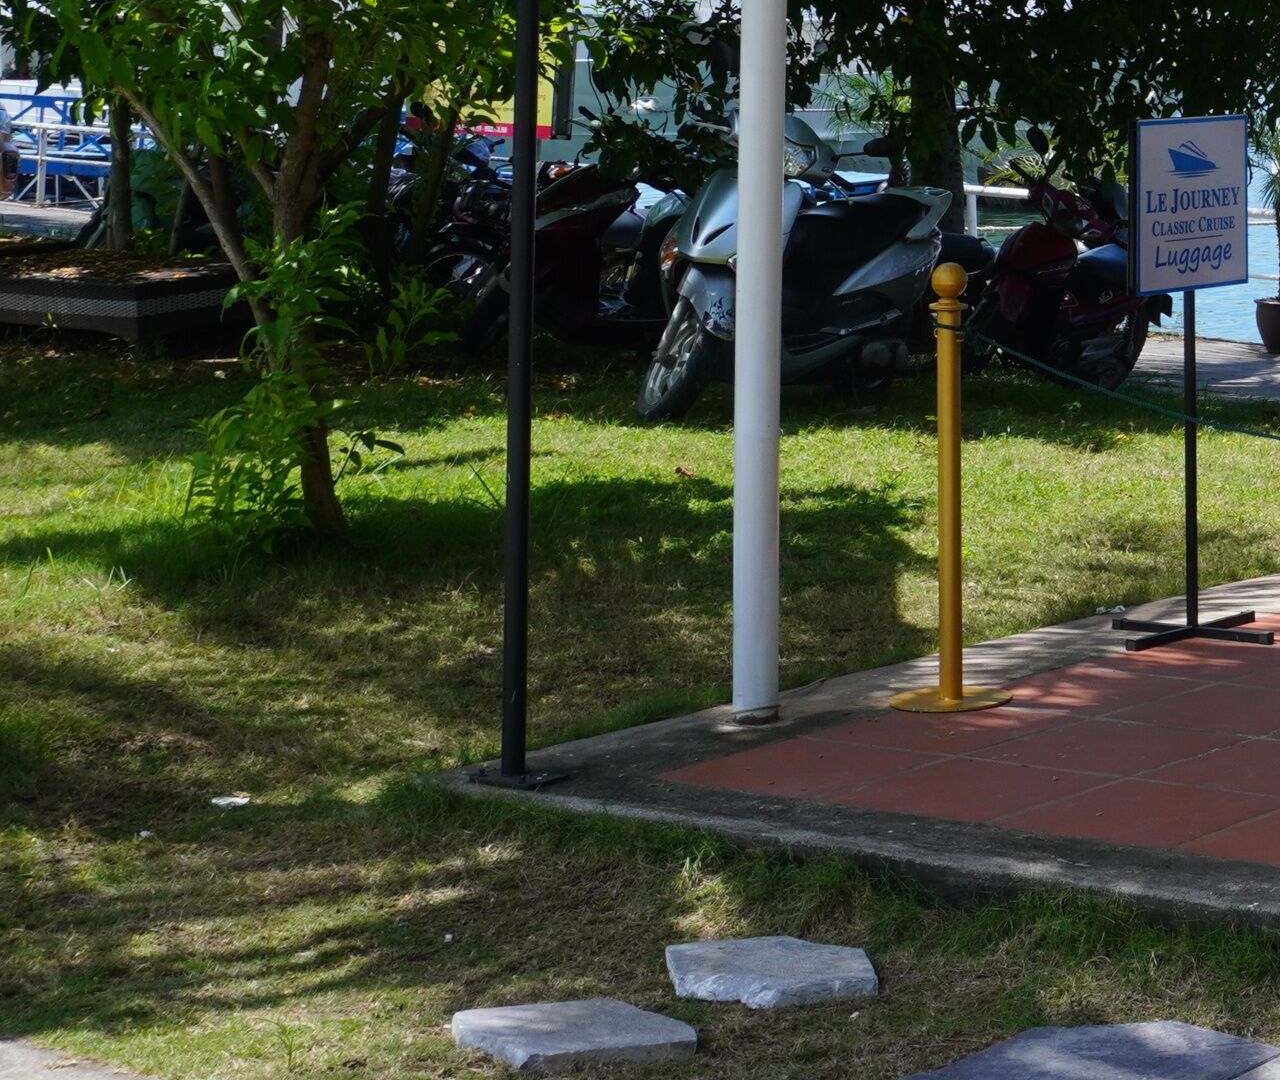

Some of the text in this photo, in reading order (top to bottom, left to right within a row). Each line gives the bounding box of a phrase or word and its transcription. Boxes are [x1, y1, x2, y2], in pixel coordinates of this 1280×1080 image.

[1146, 186, 1240, 214] LE JOURNEY
[1152, 215, 1235, 237] CLASSIC CRUISE
[1155, 242, 1233, 274] Luggage
